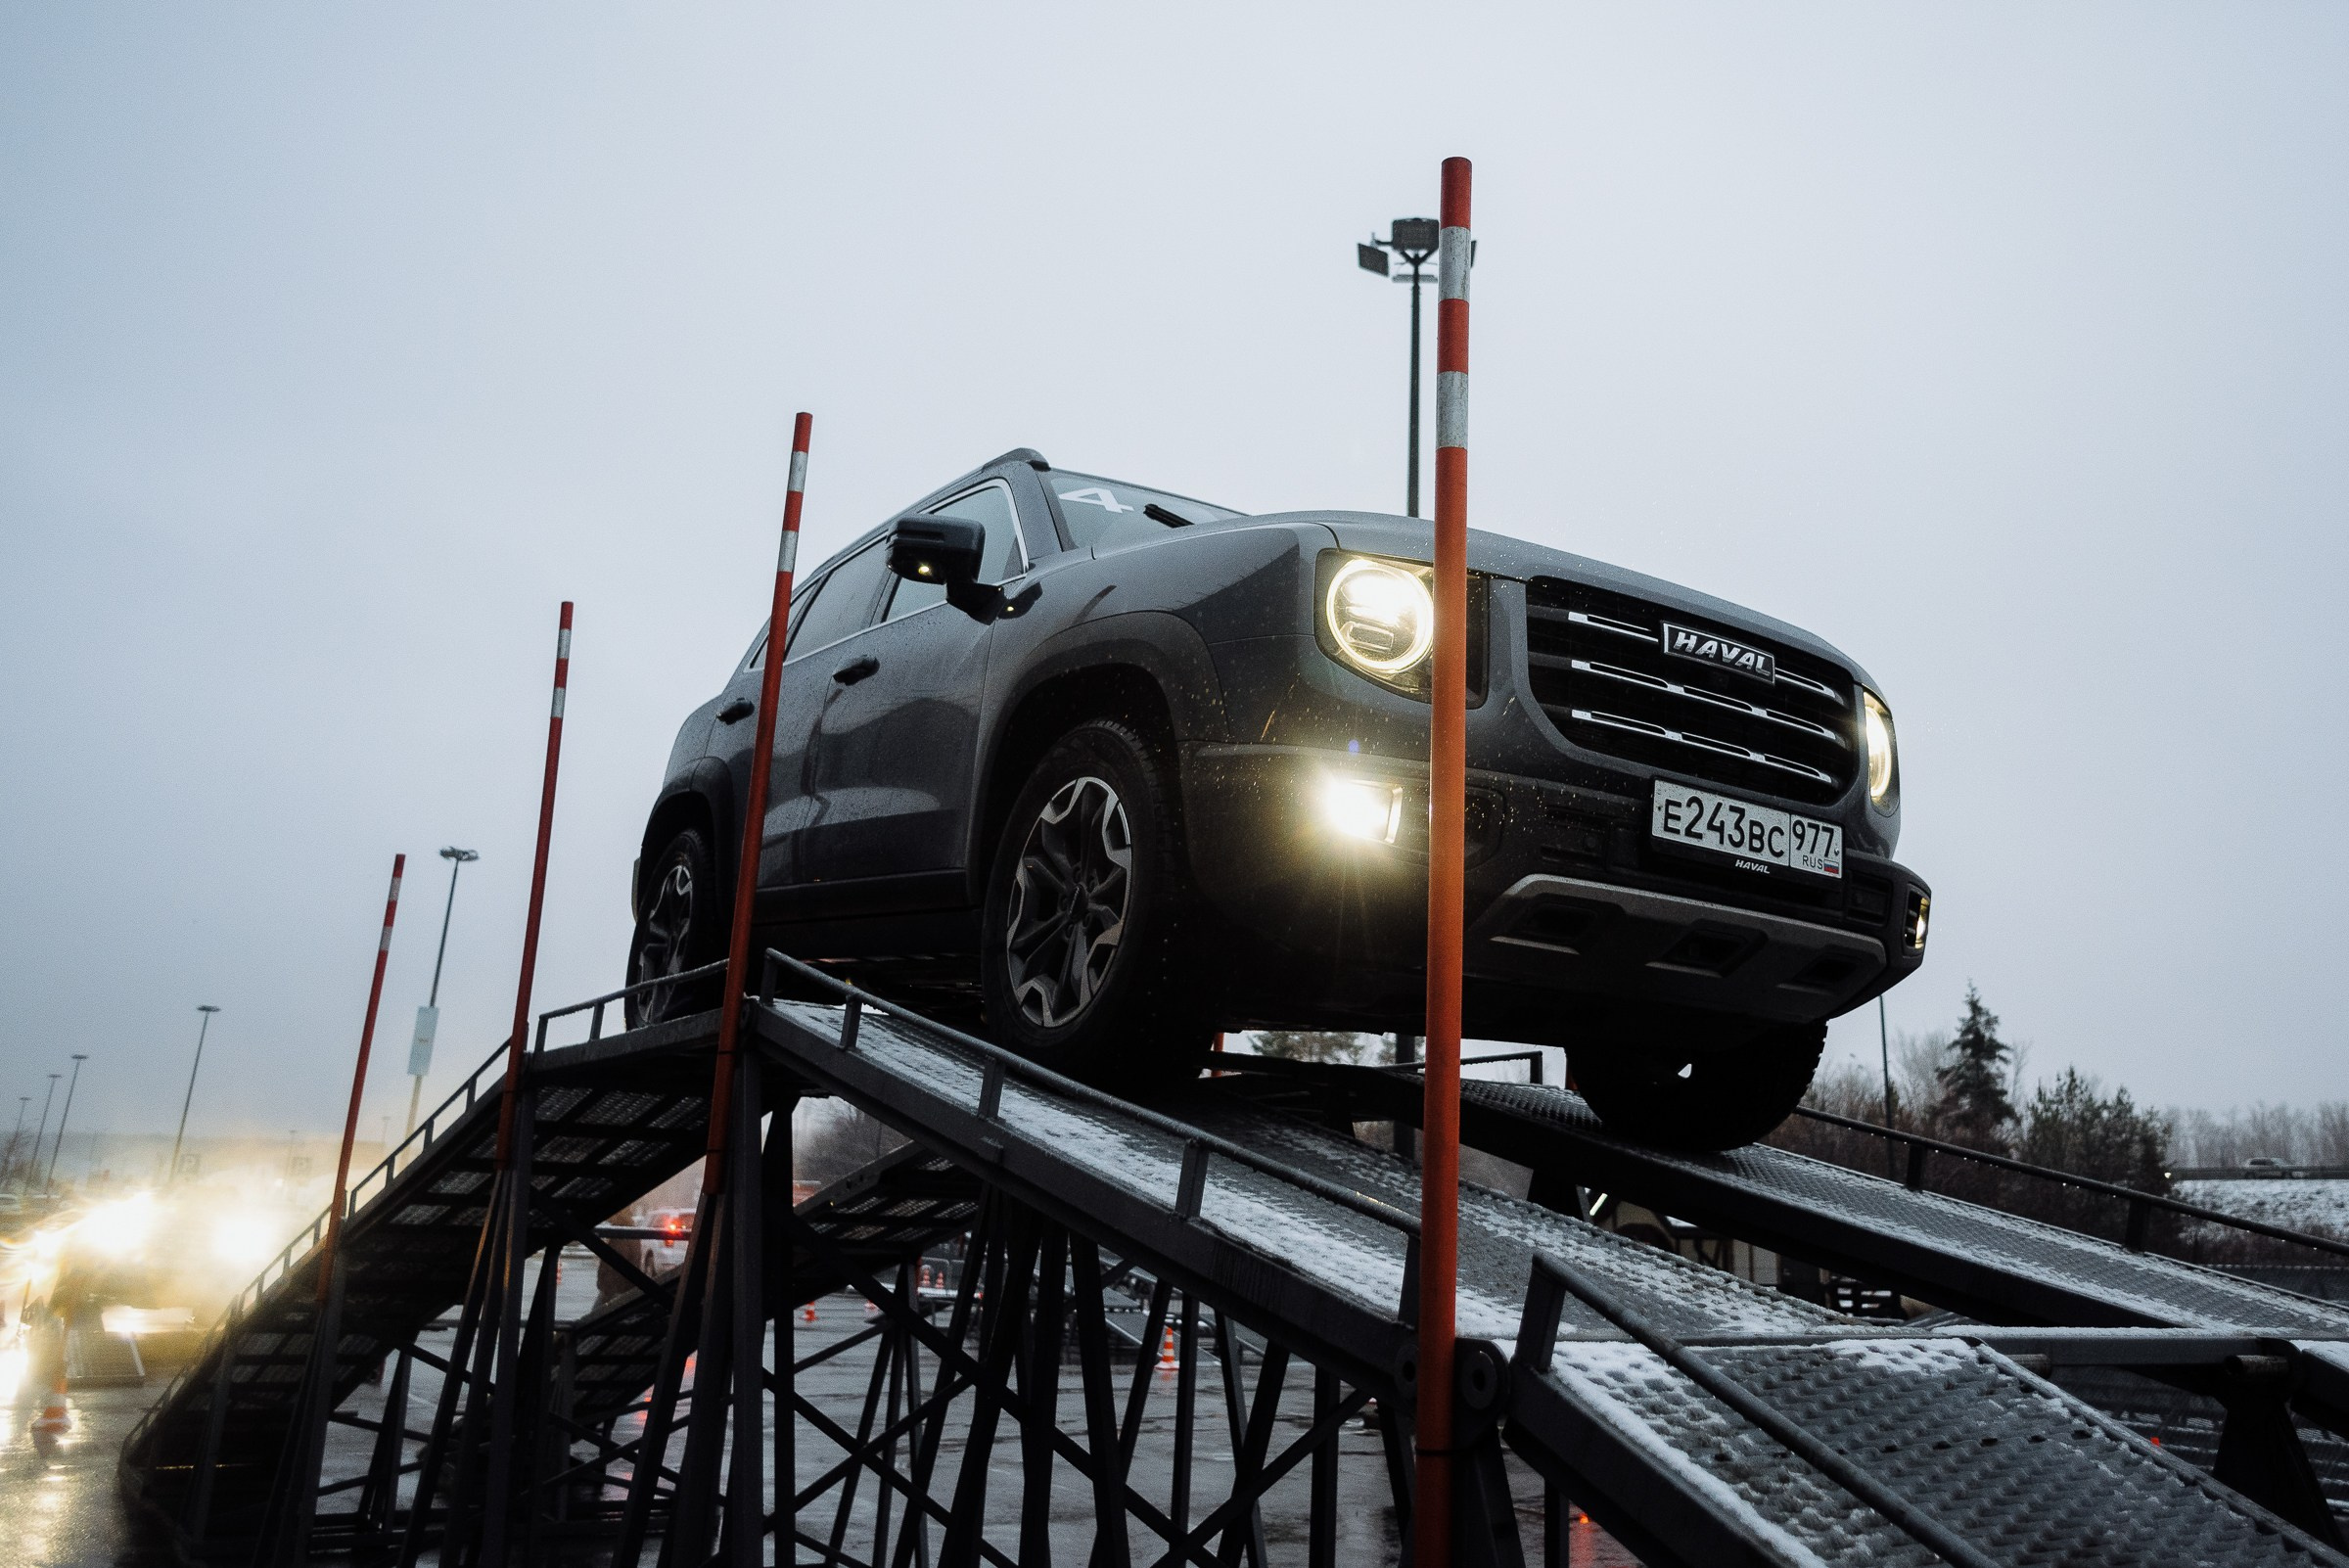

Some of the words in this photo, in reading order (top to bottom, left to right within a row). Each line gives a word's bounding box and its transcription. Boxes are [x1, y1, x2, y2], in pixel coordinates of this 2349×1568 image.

[1058, 487, 1134, 514] 4
[1673, 631, 1772, 677] HAVAL
[1663, 795, 1785, 858] E243BC
[1792, 819, 1835, 858] 977
[1734, 858, 1771, 874] HAVAL
[1802, 854, 1823, 870] RUS
